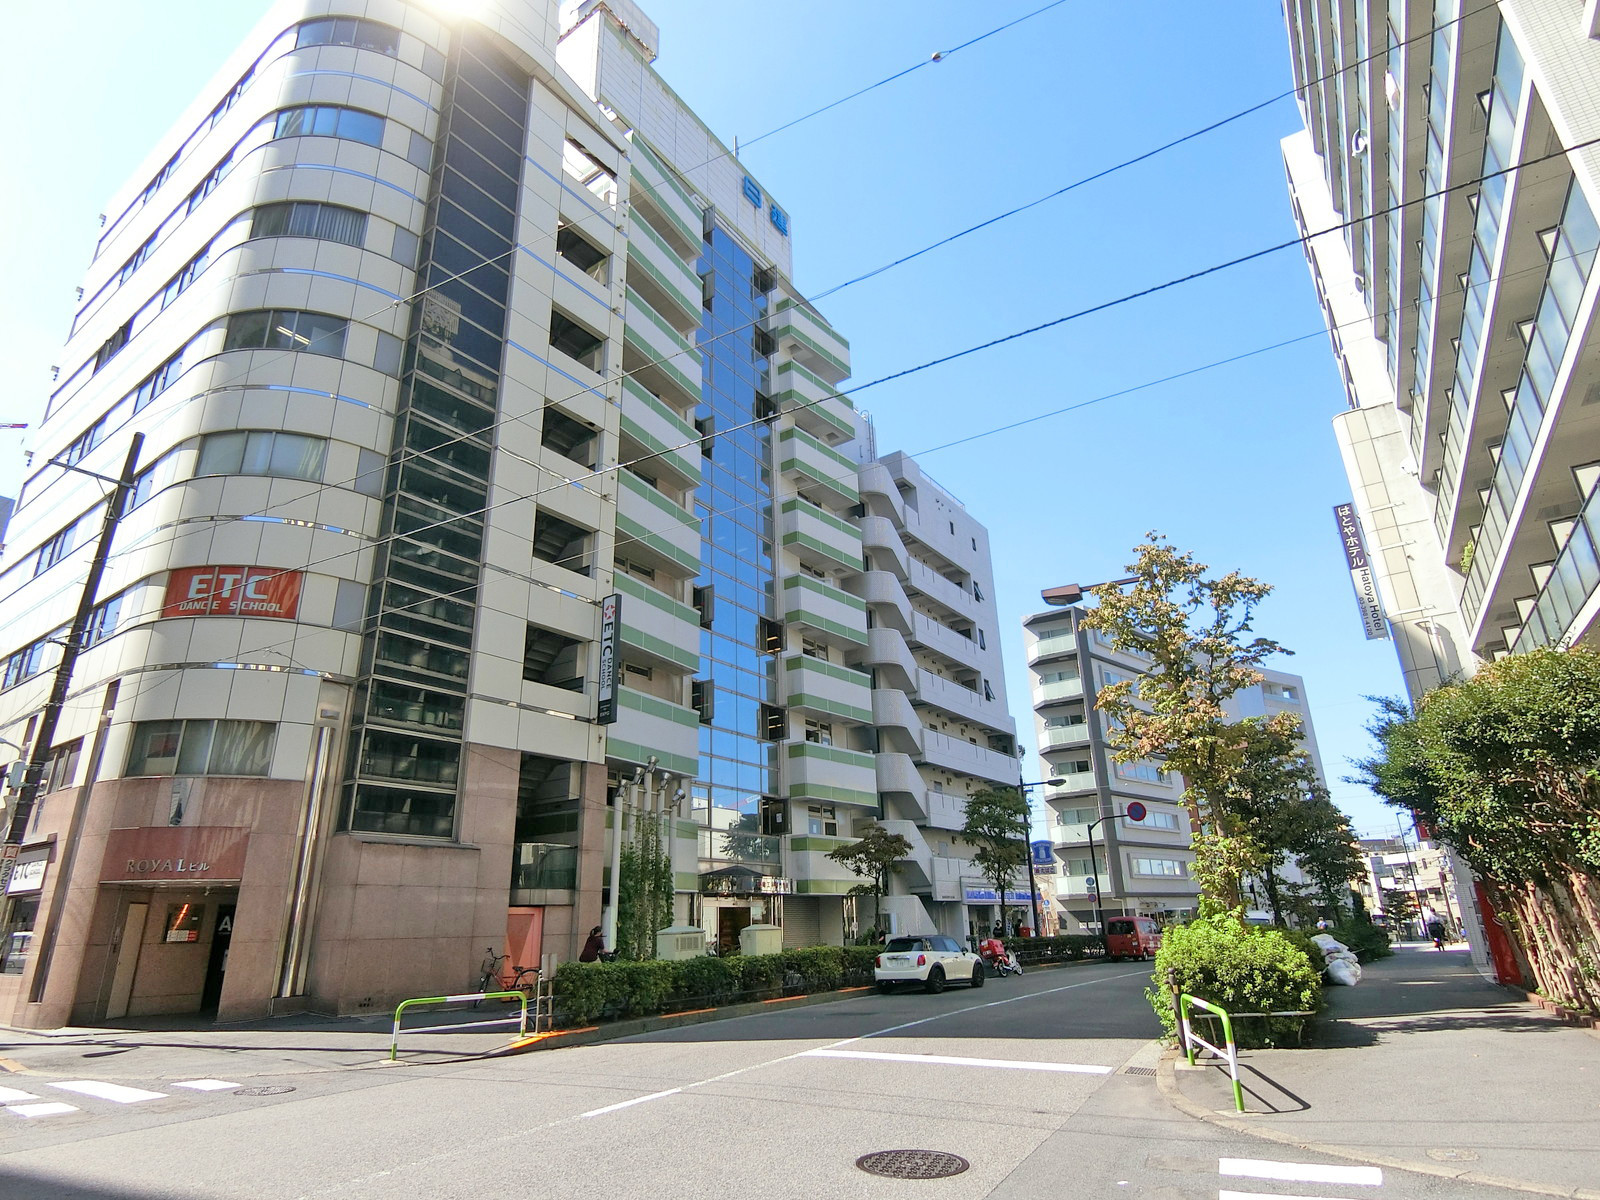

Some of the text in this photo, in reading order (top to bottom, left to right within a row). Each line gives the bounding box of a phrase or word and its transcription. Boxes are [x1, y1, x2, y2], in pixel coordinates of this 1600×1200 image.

[1337, 505, 1364, 567] はとやホテル
[187, 574, 272, 599] ETC
[1360, 568, 1385, 631] Hatoya Hotel
[180, 601, 284, 612] DANCE SCHOOL
[603, 622, 613, 656] ETC
